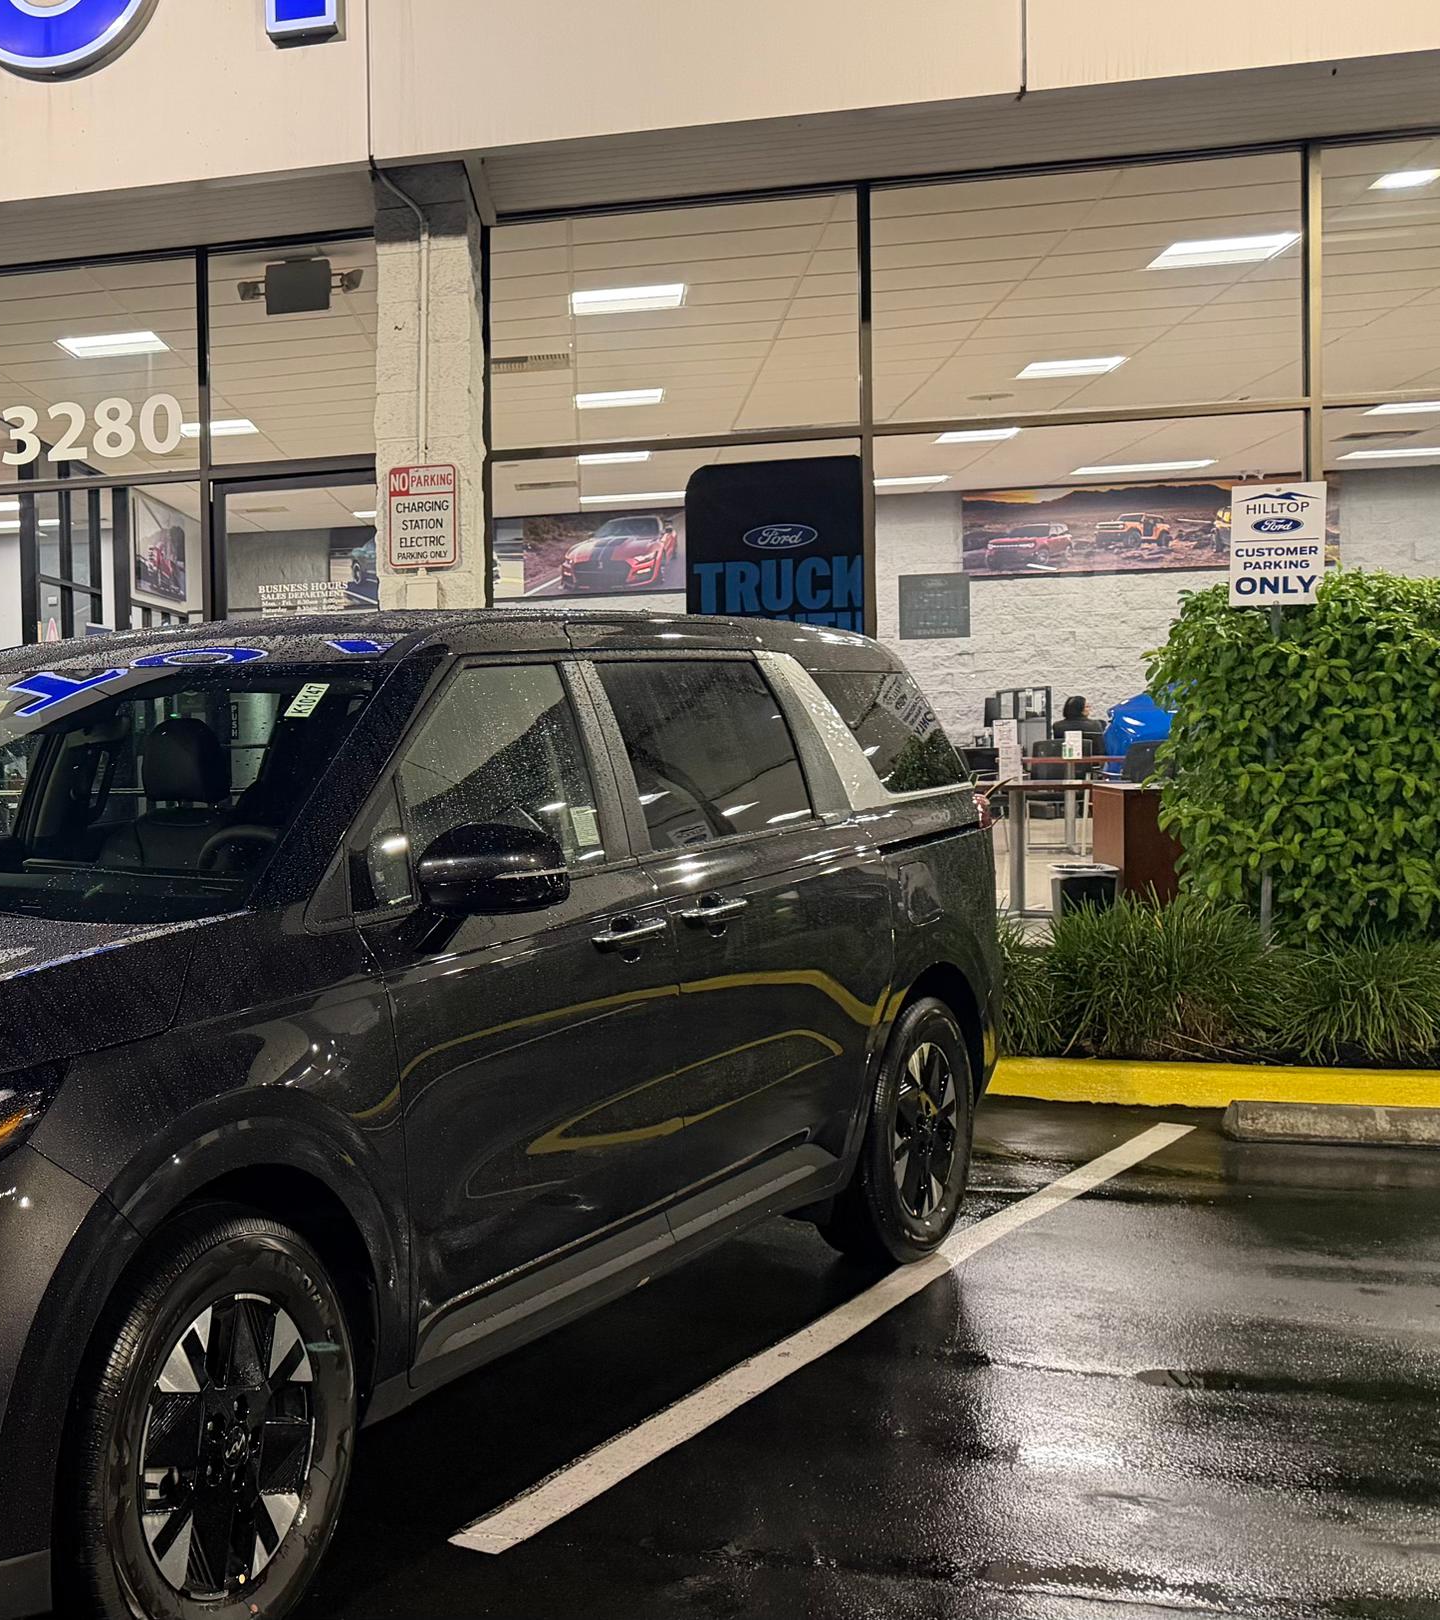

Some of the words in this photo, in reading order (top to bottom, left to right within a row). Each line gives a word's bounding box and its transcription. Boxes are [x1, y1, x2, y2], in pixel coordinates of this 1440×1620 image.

[1, 393, 183, 466] 3280
[390, 473, 408, 492] NO
[410, 473, 453, 487] PARKING
[395, 500, 449, 513] CHARGING
[1246, 501, 1310, 514] HILLTOP
[401, 518, 443, 530] STATION
[1261, 519, 1293, 531] Ford
[399, 535, 446, 548] ELECTRIC
[758, 527, 802, 545] Ford
[397, 551, 428, 560] PARKING
[430, 550, 448, 559] ONLY
[1235, 546, 1318, 558] CUSTOMER
[1243, 559, 1310, 570] PARKING
[258, 583, 308, 593] BUSINESS
[311, 581, 348, 590] HOURS
[1235, 575, 1317, 595] ONLY
[261, 592, 286, 600] SALES
[288, 590, 345, 599] DEPARTMENT
